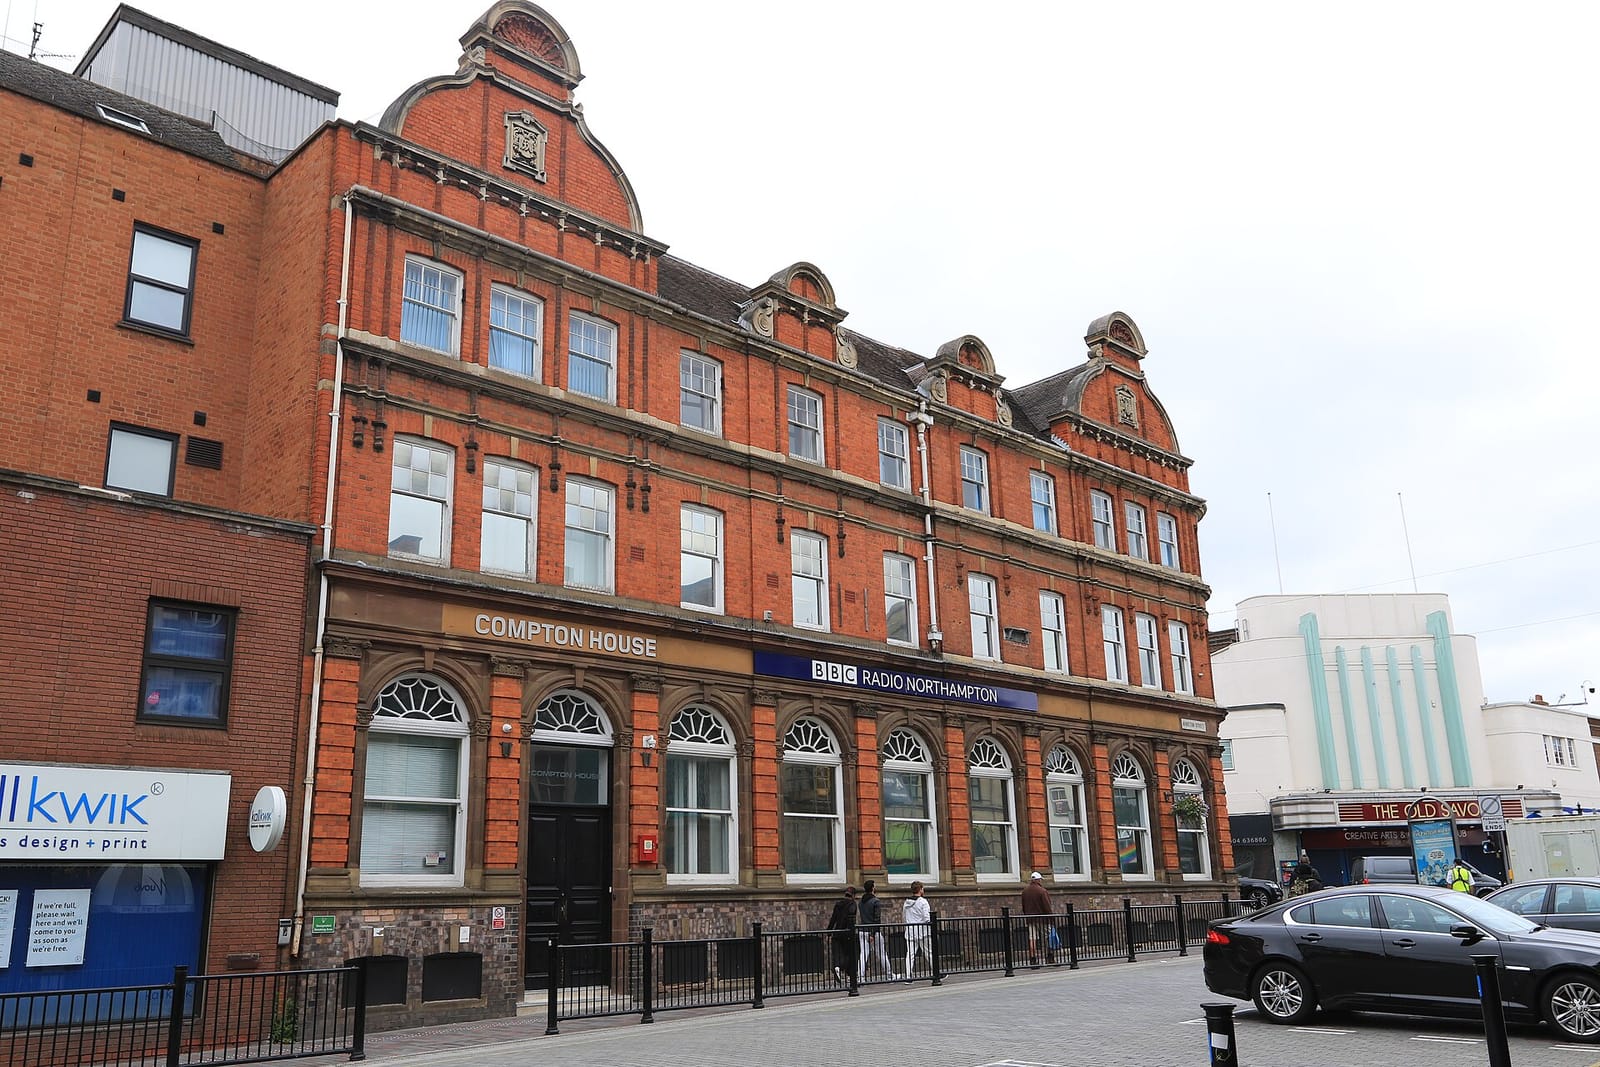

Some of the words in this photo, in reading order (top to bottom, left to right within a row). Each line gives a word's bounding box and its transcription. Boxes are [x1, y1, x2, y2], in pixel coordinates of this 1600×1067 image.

[474, 613, 583, 648] COMPTON
[589, 630, 657, 658] HOUSE
[813, 661, 857, 684] BBC
[862, 669, 903, 690] RADIO
[906, 676, 998, 703] NORTHAMPTON
[530, 769, 572, 778] COMPTON
[1372, 803, 1399, 819] THE
[1404, 803, 1436, 818] OLD
[1440, 802, 1480, 817] SAVO
[19, 835, 79, 851] design
[102, 838, 147, 851] print
[1344, 831, 1378, 841] CREATIVE
[1380, 831, 1398, 840] ARTS
